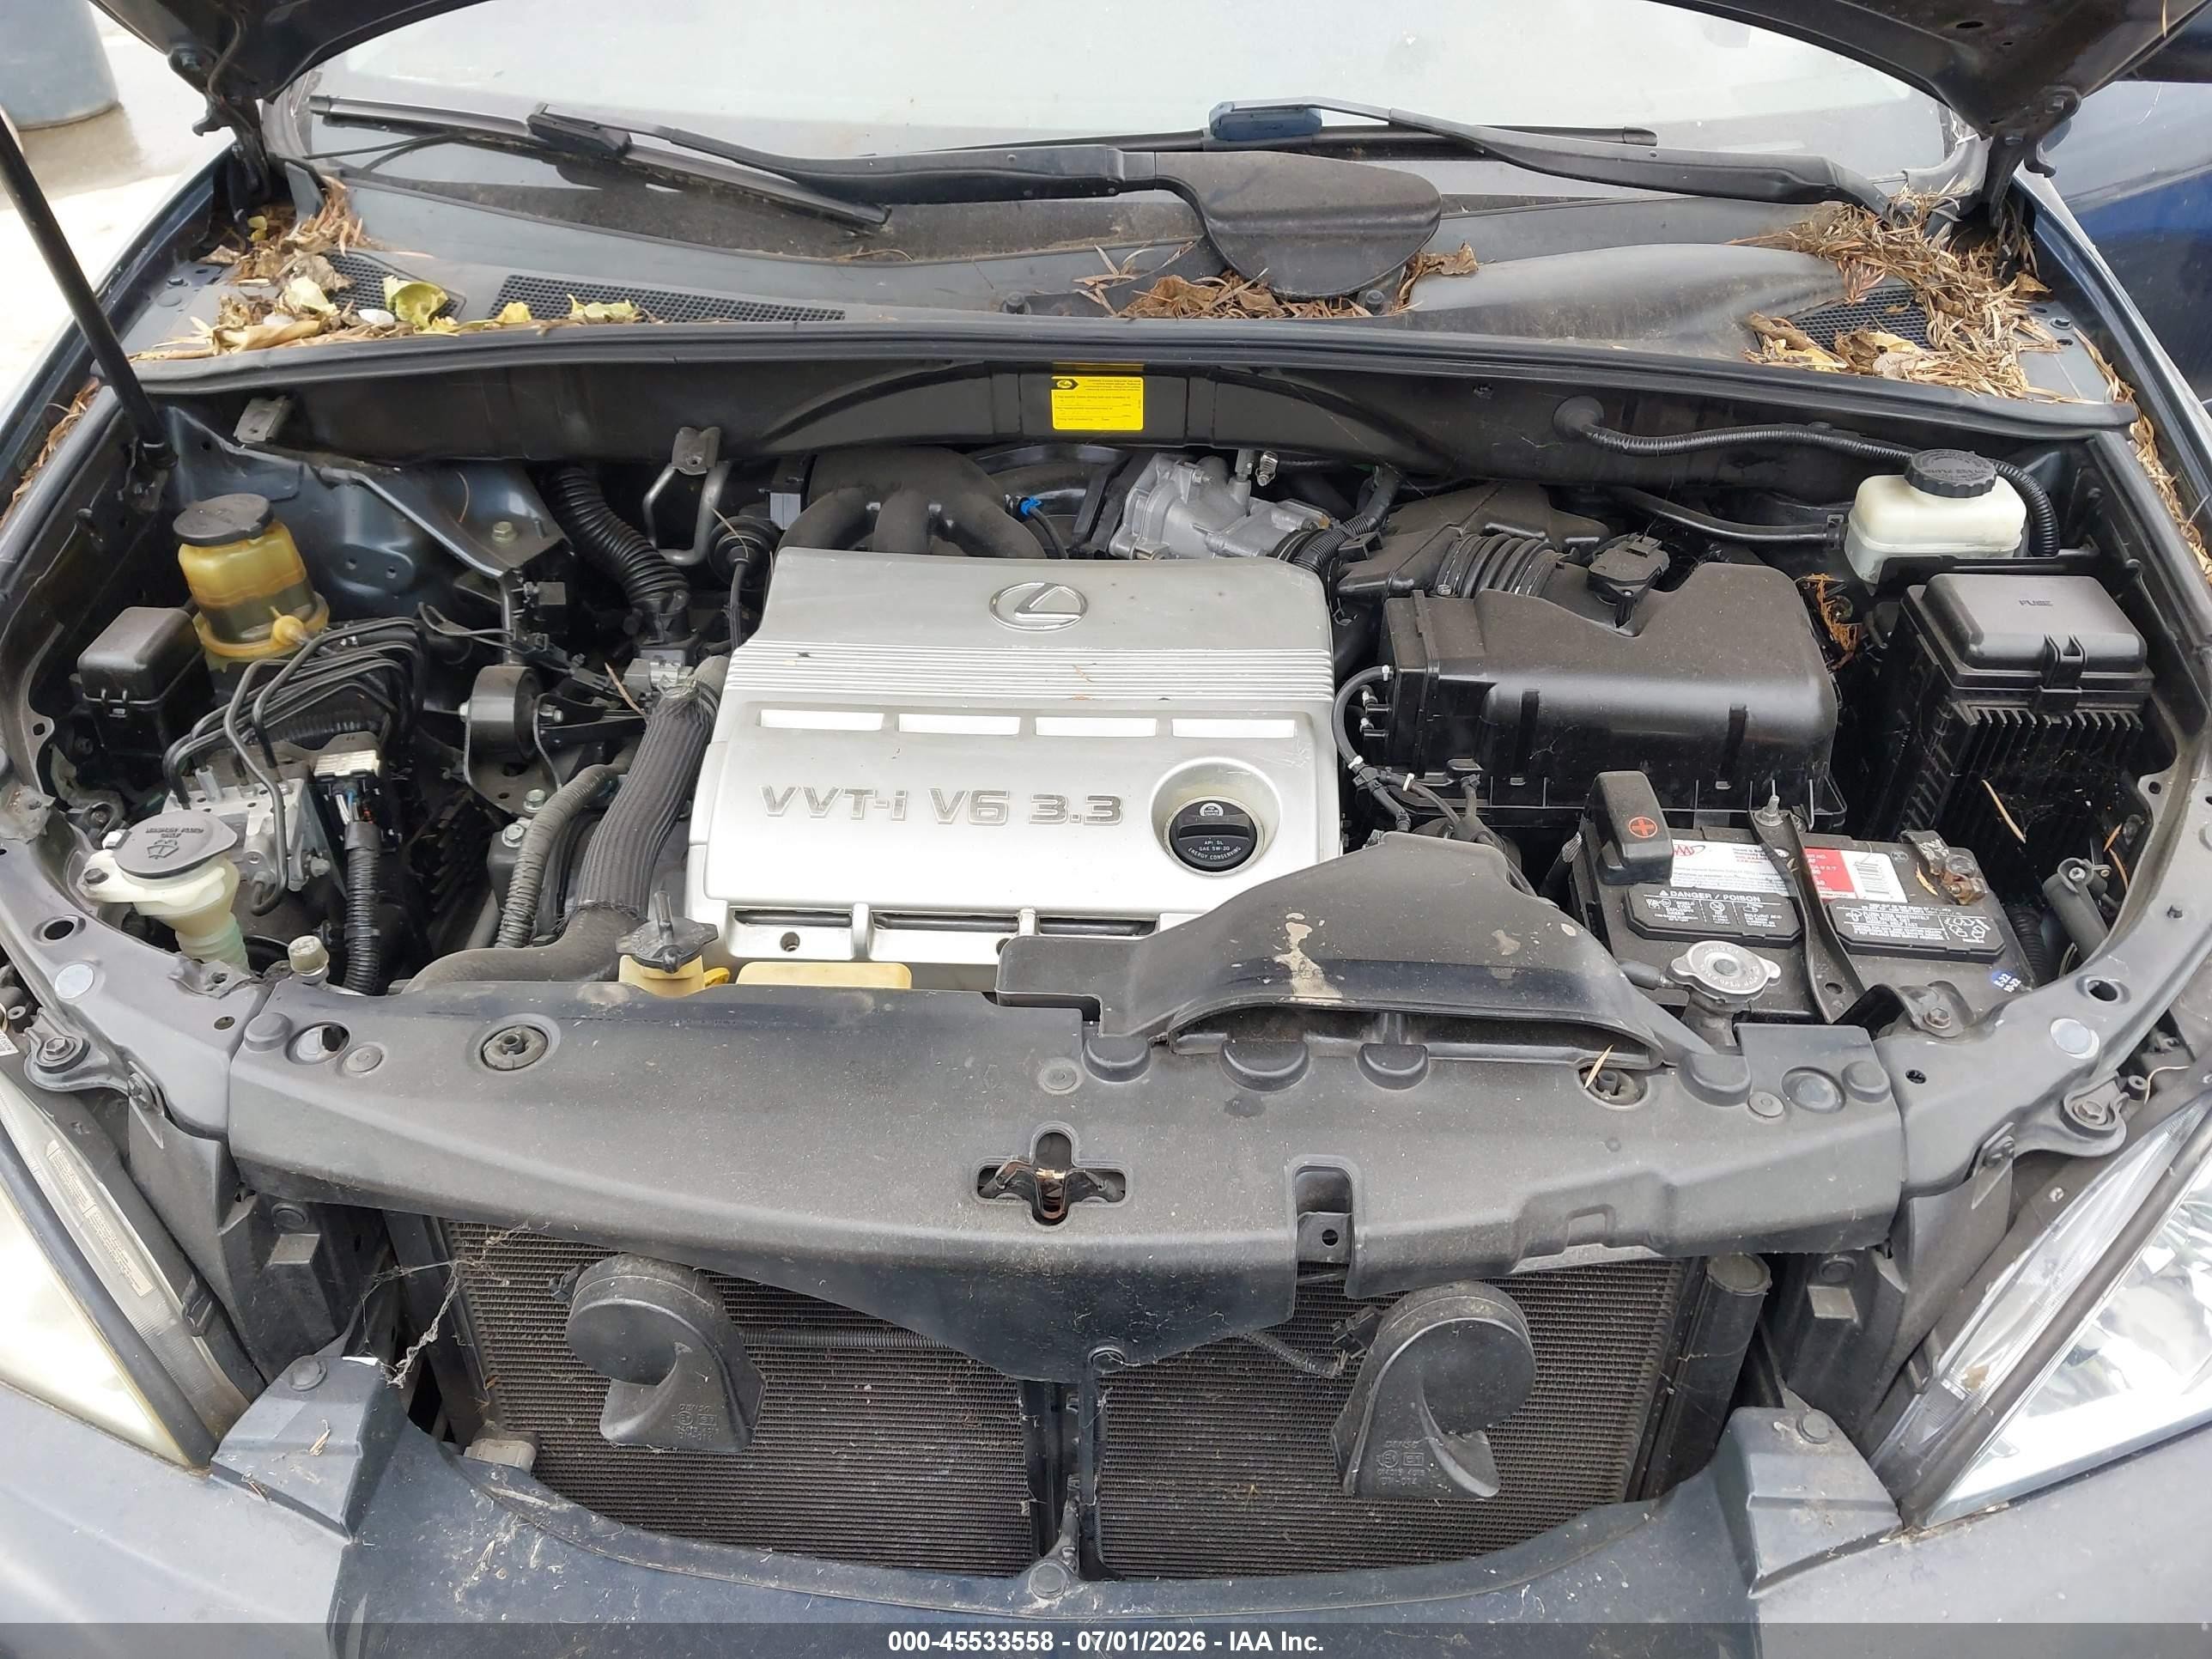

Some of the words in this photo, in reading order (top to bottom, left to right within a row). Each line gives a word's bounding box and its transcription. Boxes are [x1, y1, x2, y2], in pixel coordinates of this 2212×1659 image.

[760, 785, 908, 822] VVT-i
[928, 787, 1011, 826] V6
[1028, 792, 1124, 828] 3.3
[1188, 847, 1208, 860] ENERGY
[1209, 845, 1242, 860] CONSERVING
[1669, 890, 1713, 900] DANGER
[1723, 894, 1761, 902] POISON
